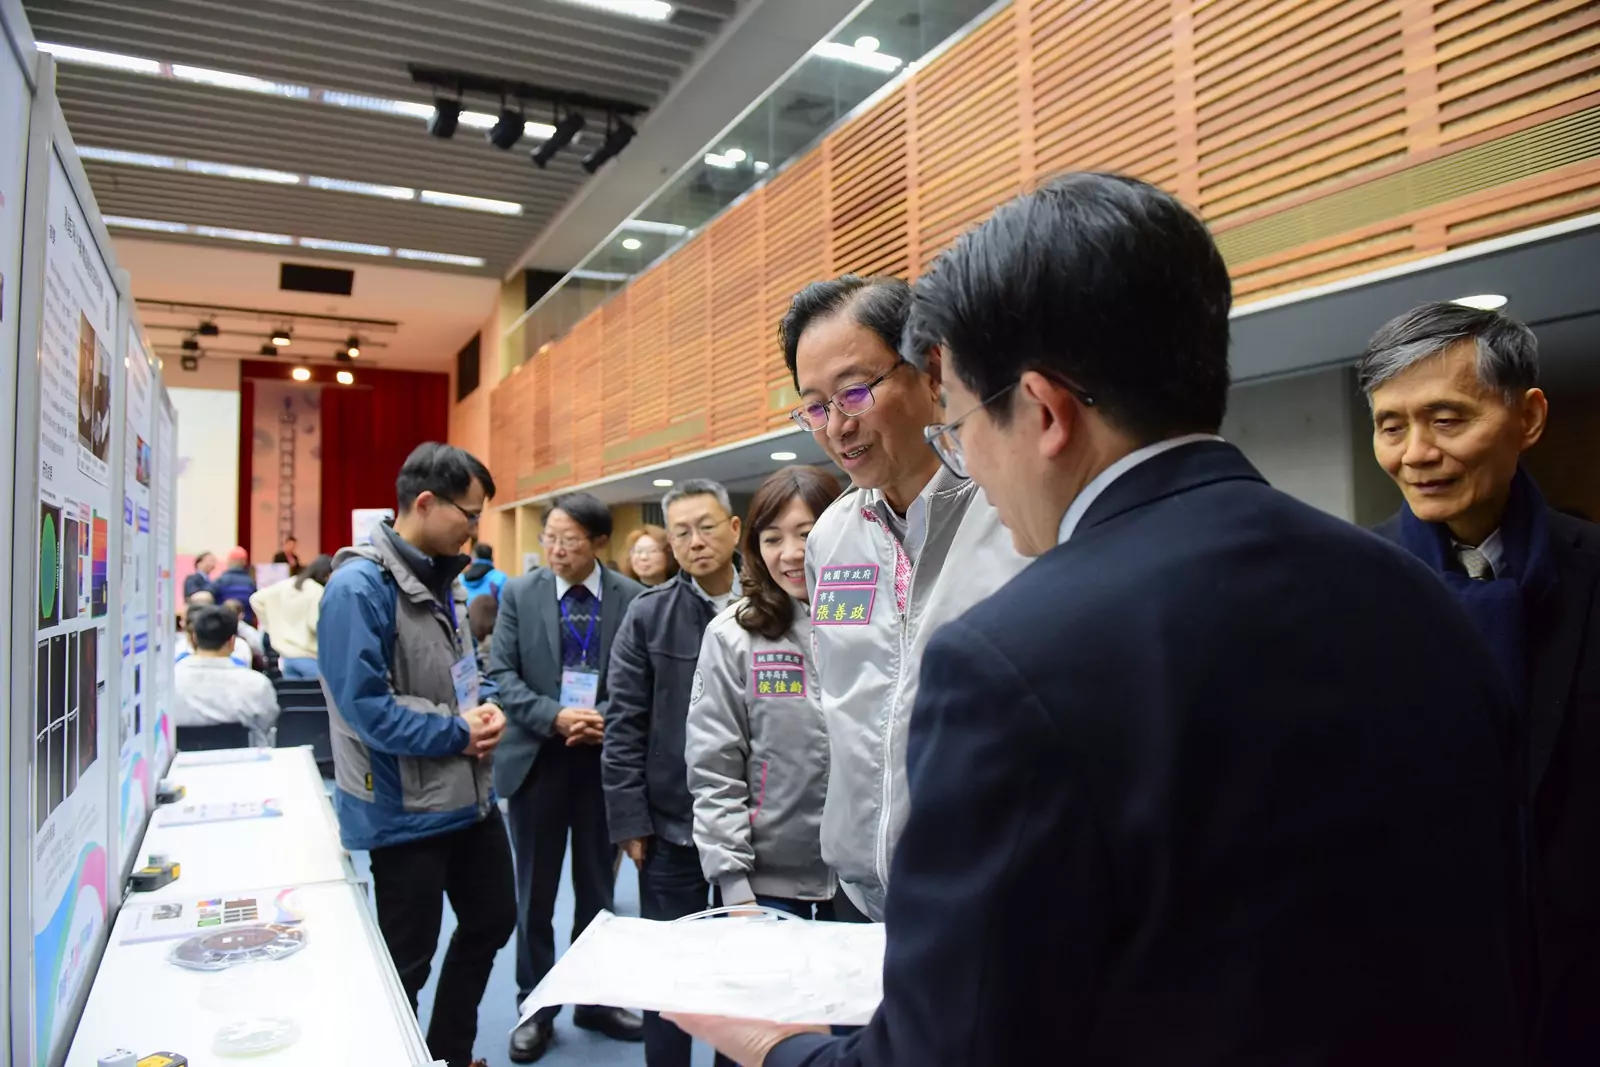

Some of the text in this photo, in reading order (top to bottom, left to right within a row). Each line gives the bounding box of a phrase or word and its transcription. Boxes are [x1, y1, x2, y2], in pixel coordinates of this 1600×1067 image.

[823, 569, 872, 581] 桃園市政府
[819, 591, 835, 603] 市長
[816, 603, 865, 621] 張善政
